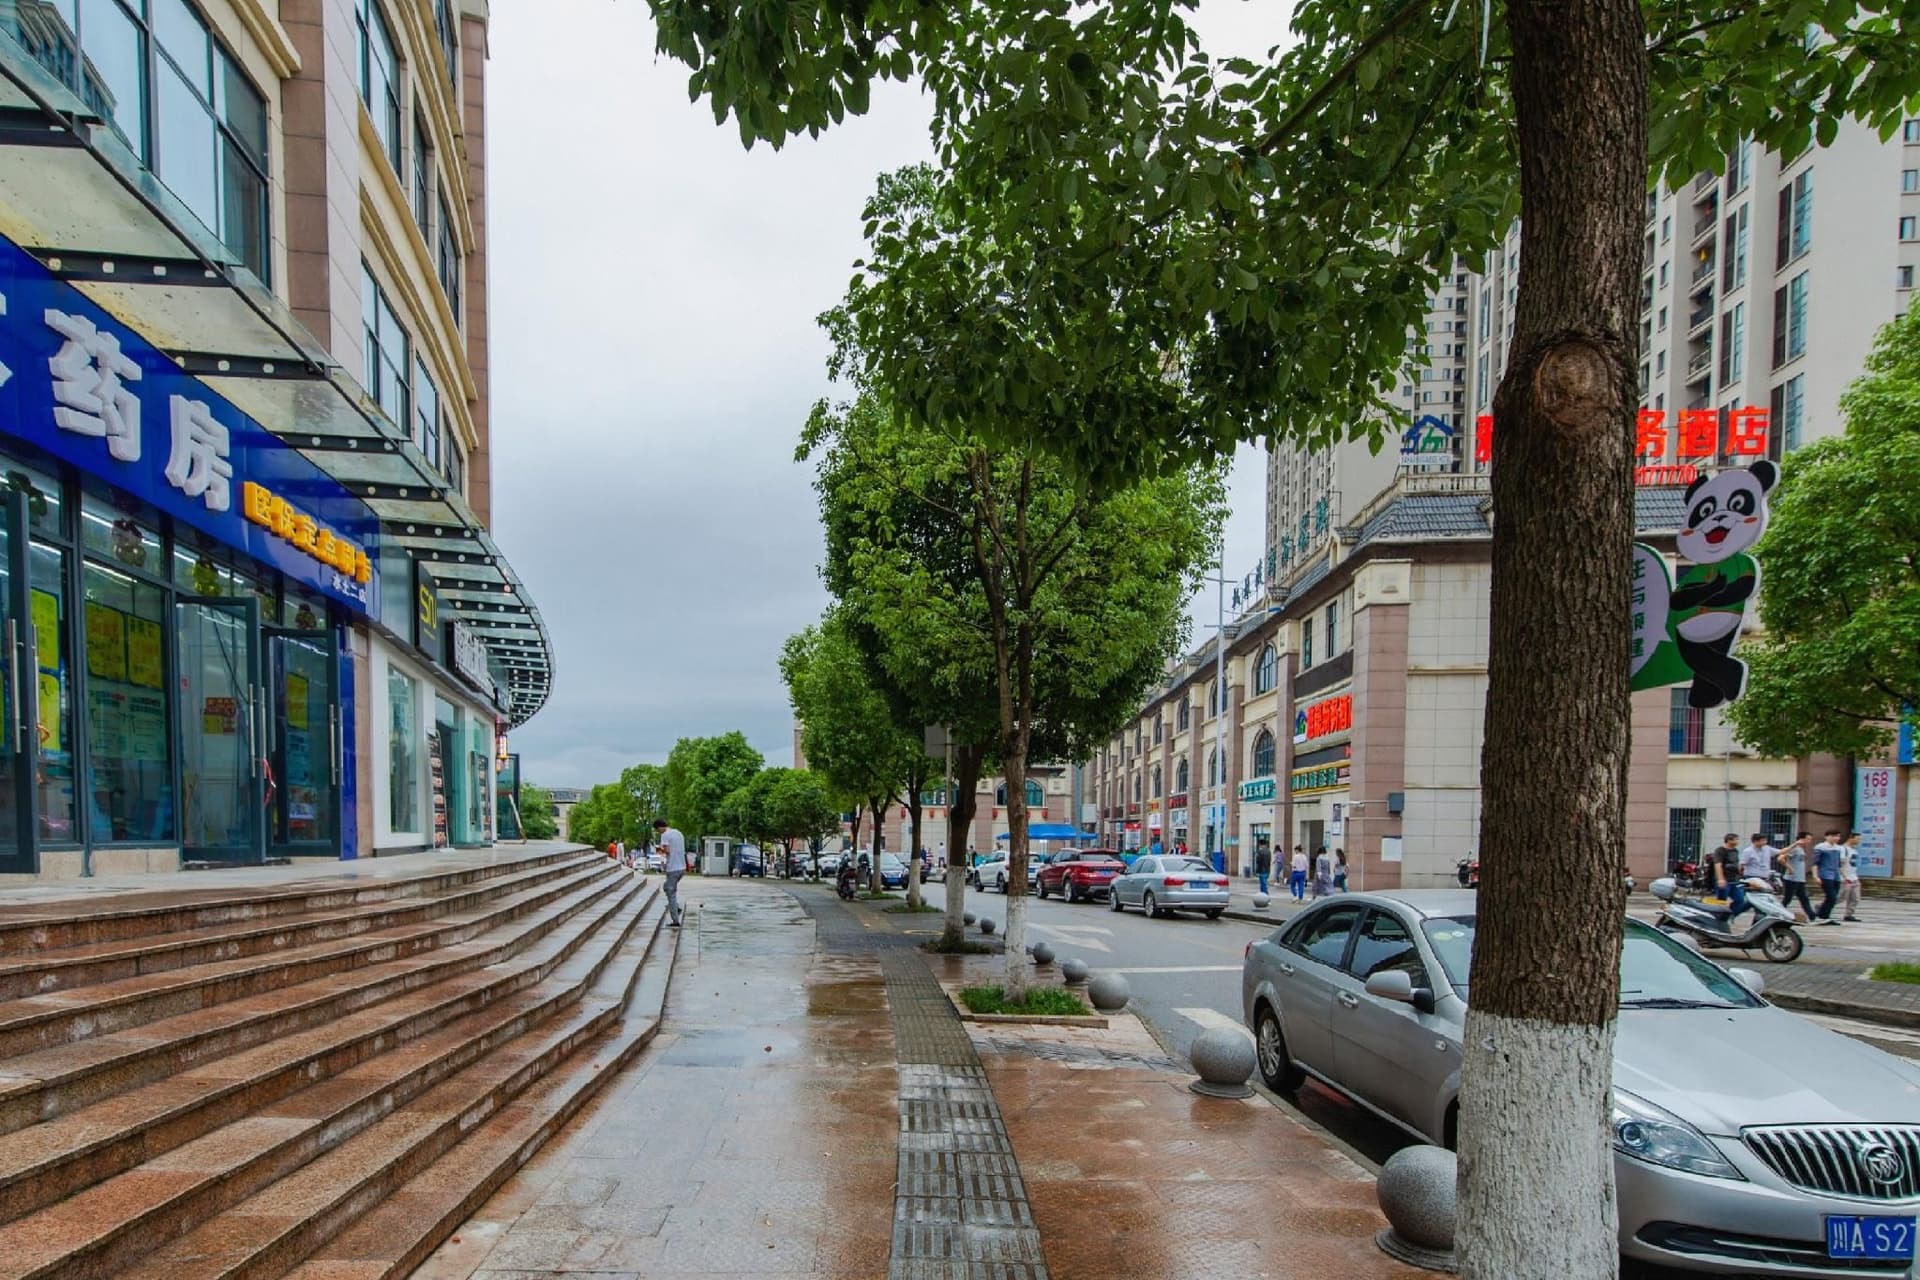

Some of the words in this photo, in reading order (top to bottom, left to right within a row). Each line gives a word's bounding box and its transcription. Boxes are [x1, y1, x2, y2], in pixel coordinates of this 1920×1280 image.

[0, 292, 232, 512] 药房
[1864, 771, 1888, 787] 168
[1833, 1222, 1916, 1252] 川A·S2
